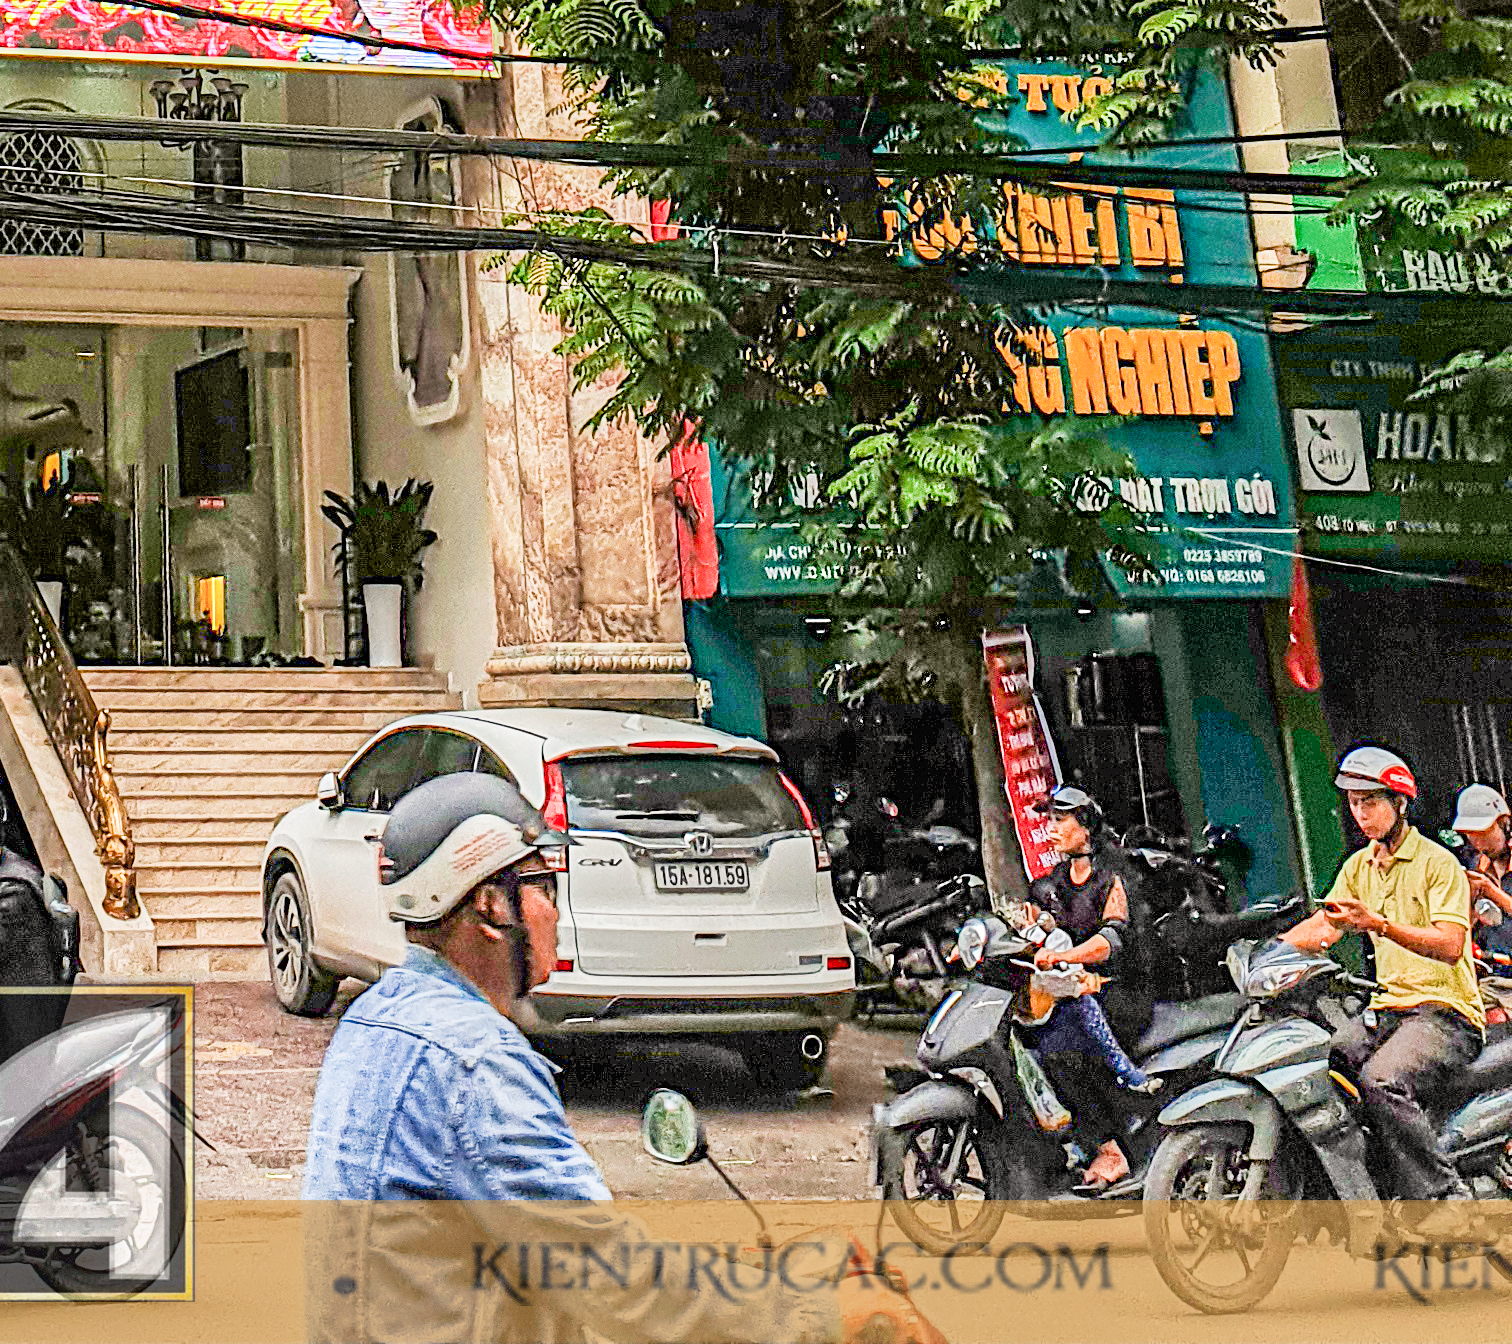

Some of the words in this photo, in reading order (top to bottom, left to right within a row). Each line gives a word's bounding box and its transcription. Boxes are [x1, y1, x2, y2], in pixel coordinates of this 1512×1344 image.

[1064, 313, 1242, 436] NGHIỆP
[1234, 471, 1278, 515] GÓI
[660, 865, 746, 887] 15A-181.59
